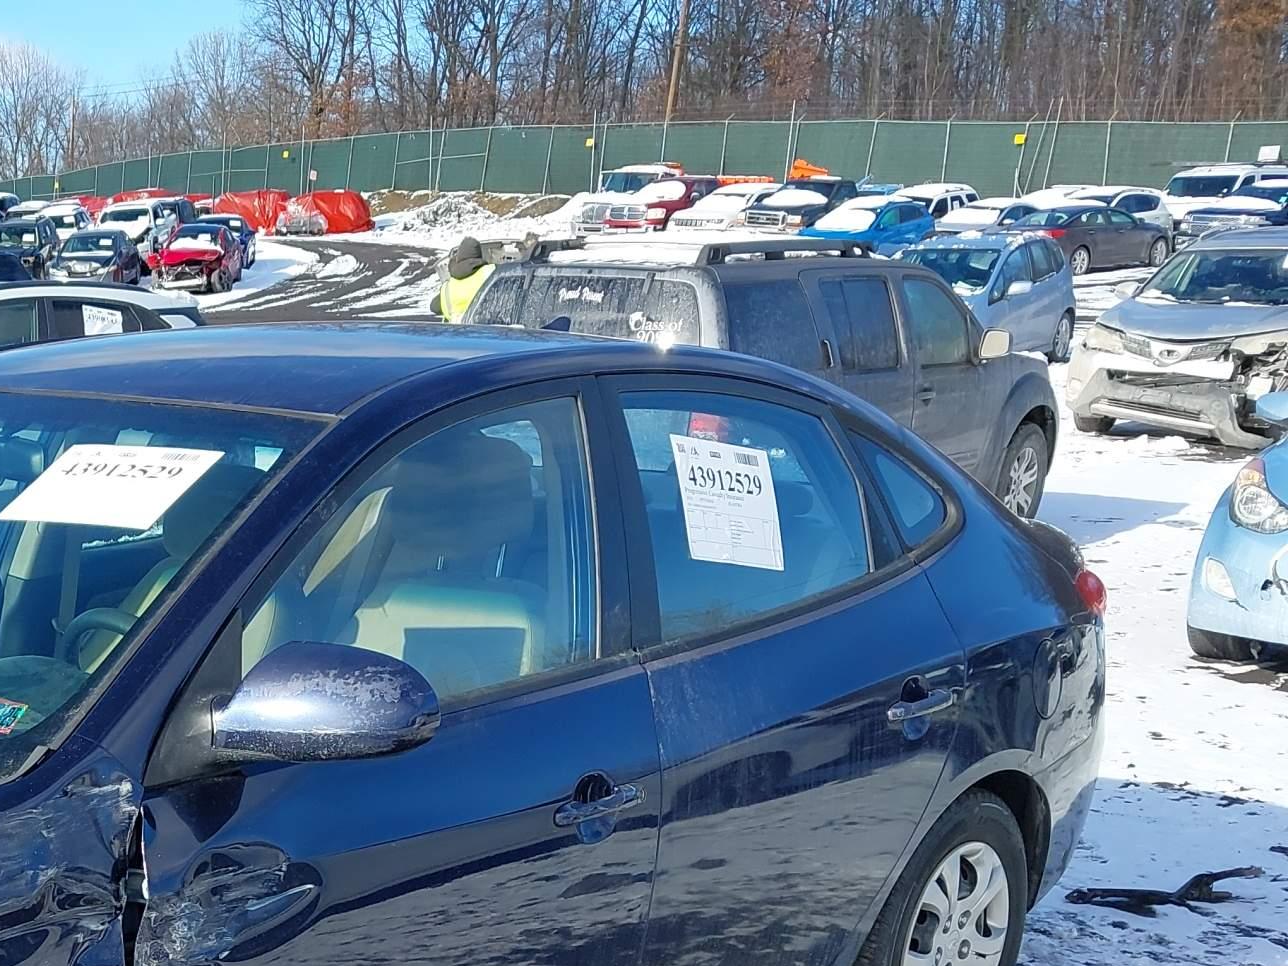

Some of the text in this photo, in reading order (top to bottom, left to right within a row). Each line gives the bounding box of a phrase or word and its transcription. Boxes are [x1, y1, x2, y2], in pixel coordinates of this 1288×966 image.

[632, 316, 683, 332] Class of
[62, 463, 184, 478] 43912529
[688, 464, 762, 497] 43912529
